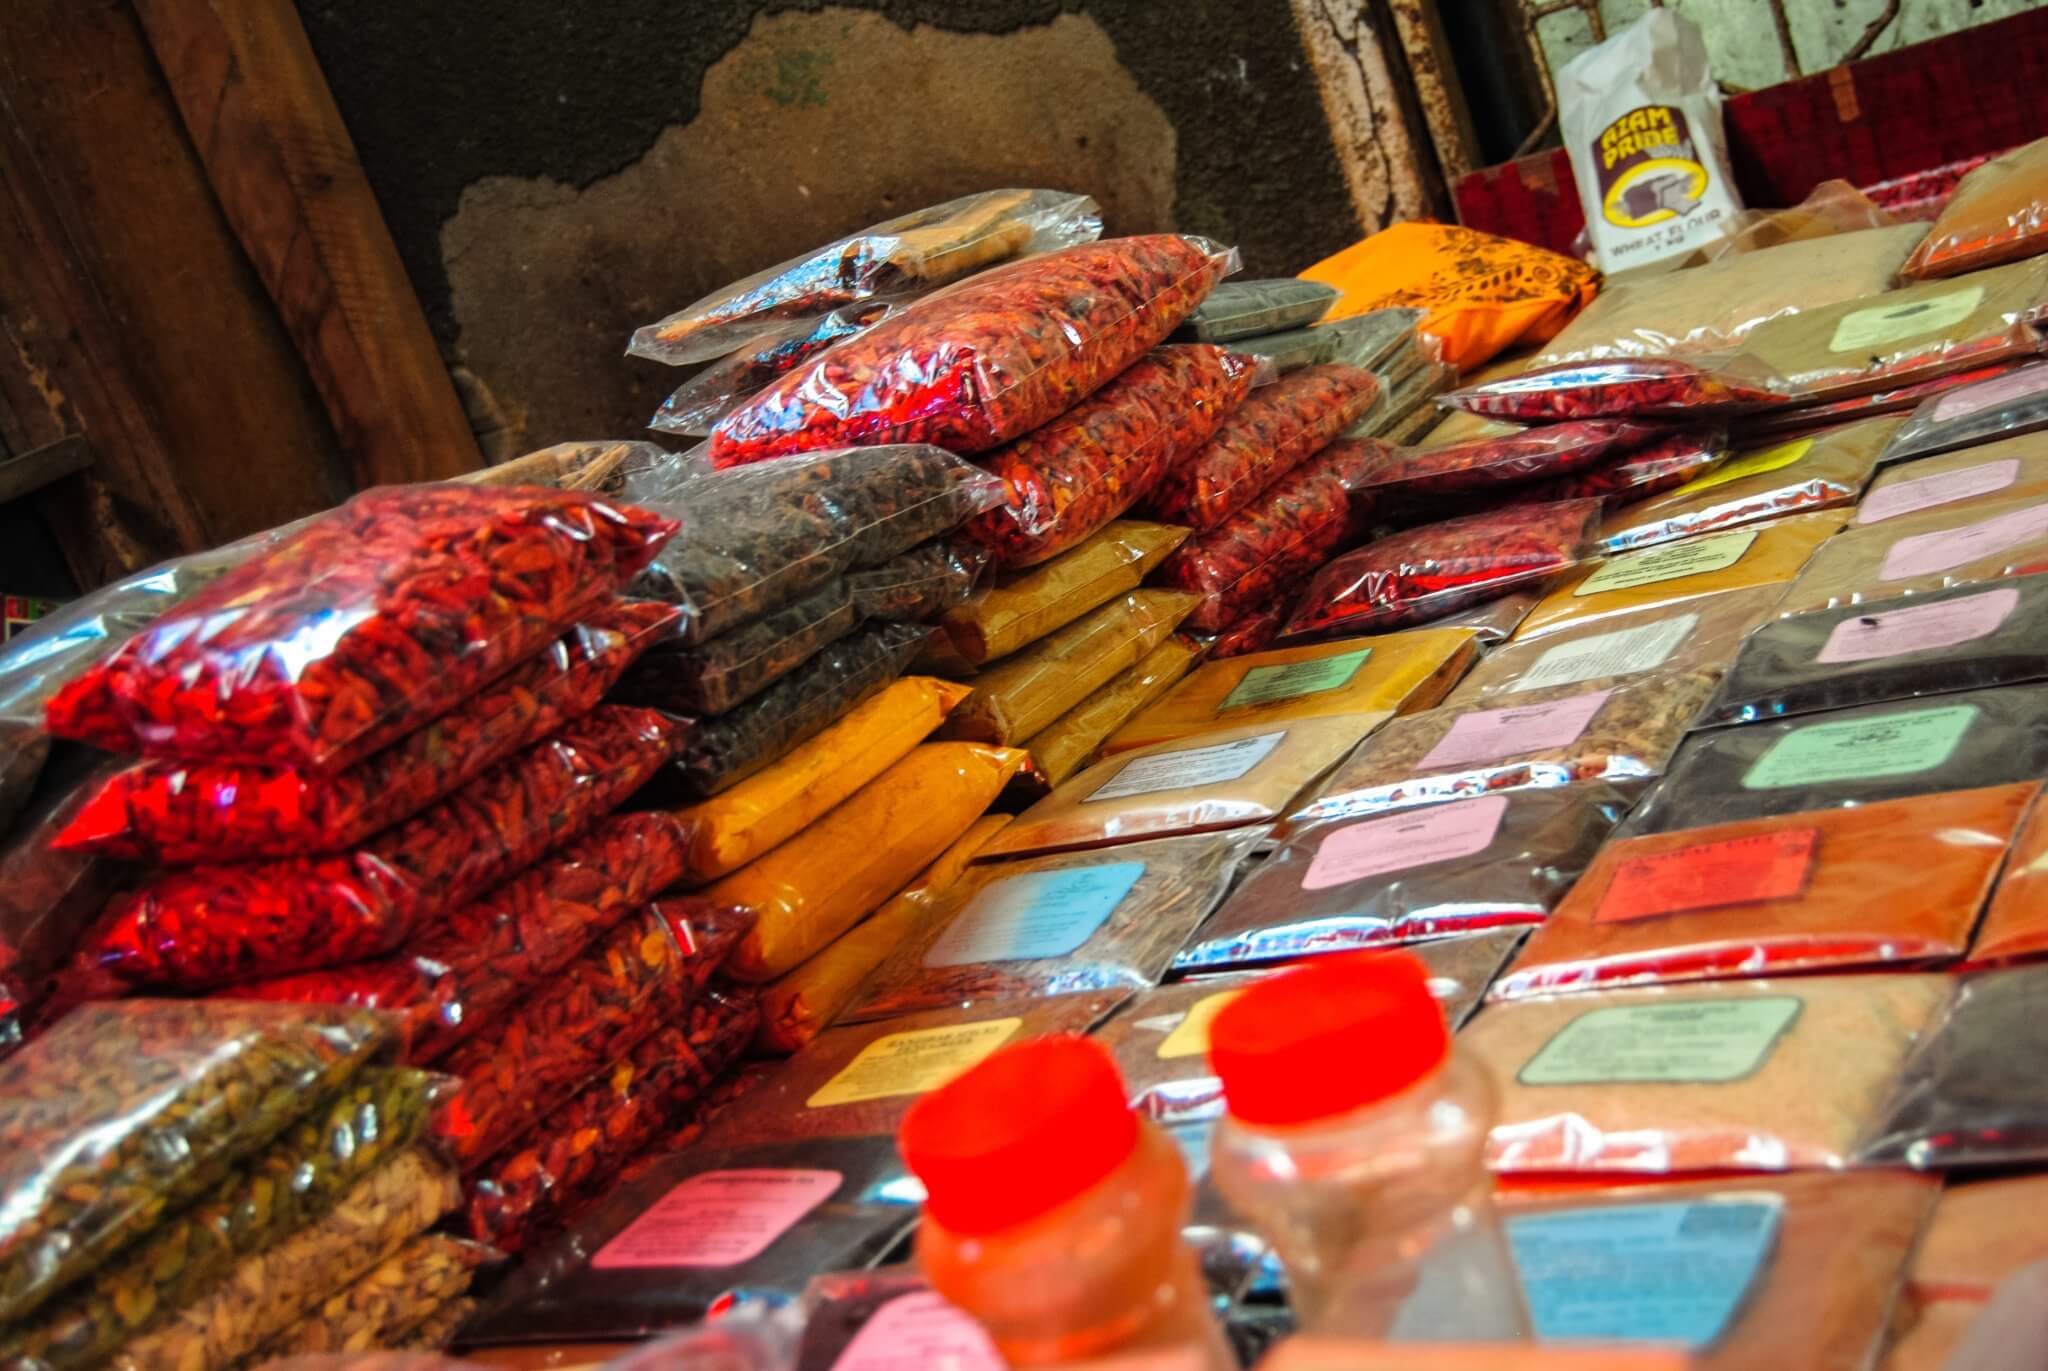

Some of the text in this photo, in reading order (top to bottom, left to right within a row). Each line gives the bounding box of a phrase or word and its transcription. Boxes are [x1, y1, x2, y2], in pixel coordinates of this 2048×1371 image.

[1601, 107, 1672, 150] AZAM
[1602, 127, 1680, 170] PRIDE
[1610, 230, 1662, 257] WHEAT
